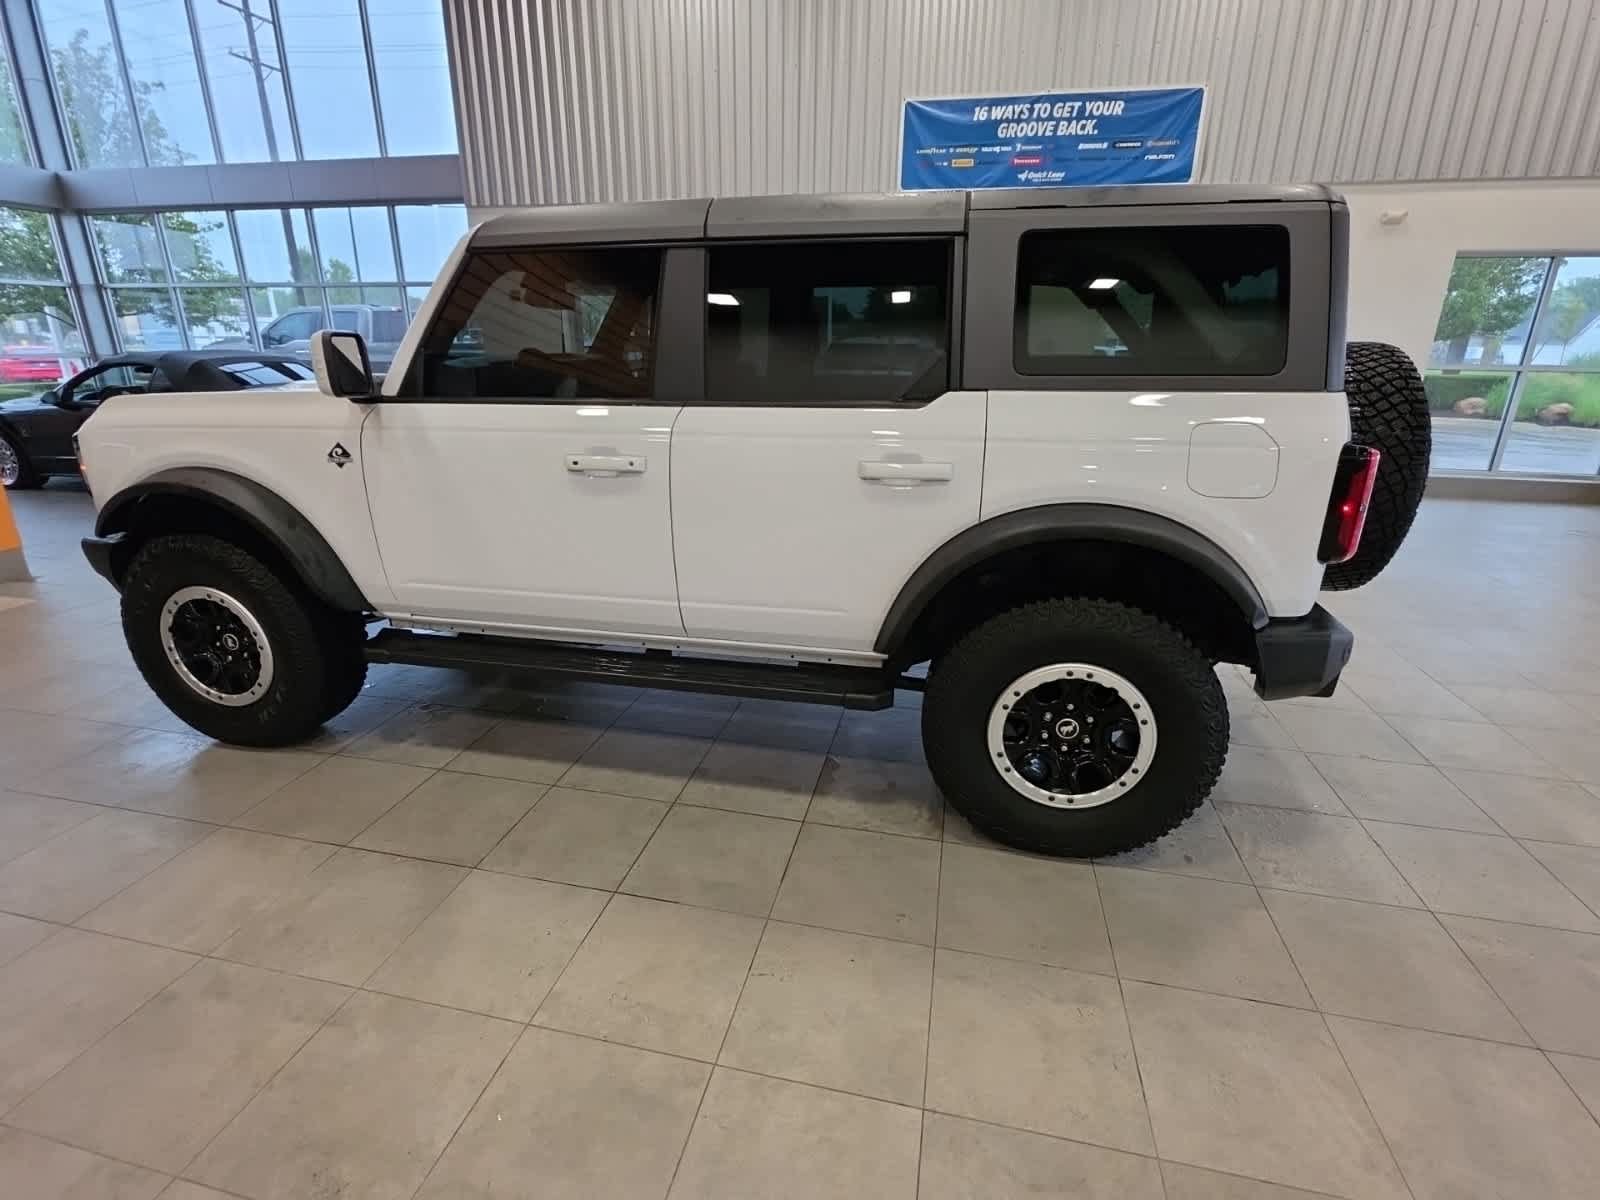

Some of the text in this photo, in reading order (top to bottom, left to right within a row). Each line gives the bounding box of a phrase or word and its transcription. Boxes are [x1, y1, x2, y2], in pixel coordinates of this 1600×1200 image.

[973, 100, 1125, 121] 16 WAYS TO GET YOUR
[997, 119, 1099, 139] GROOVE BACK.
